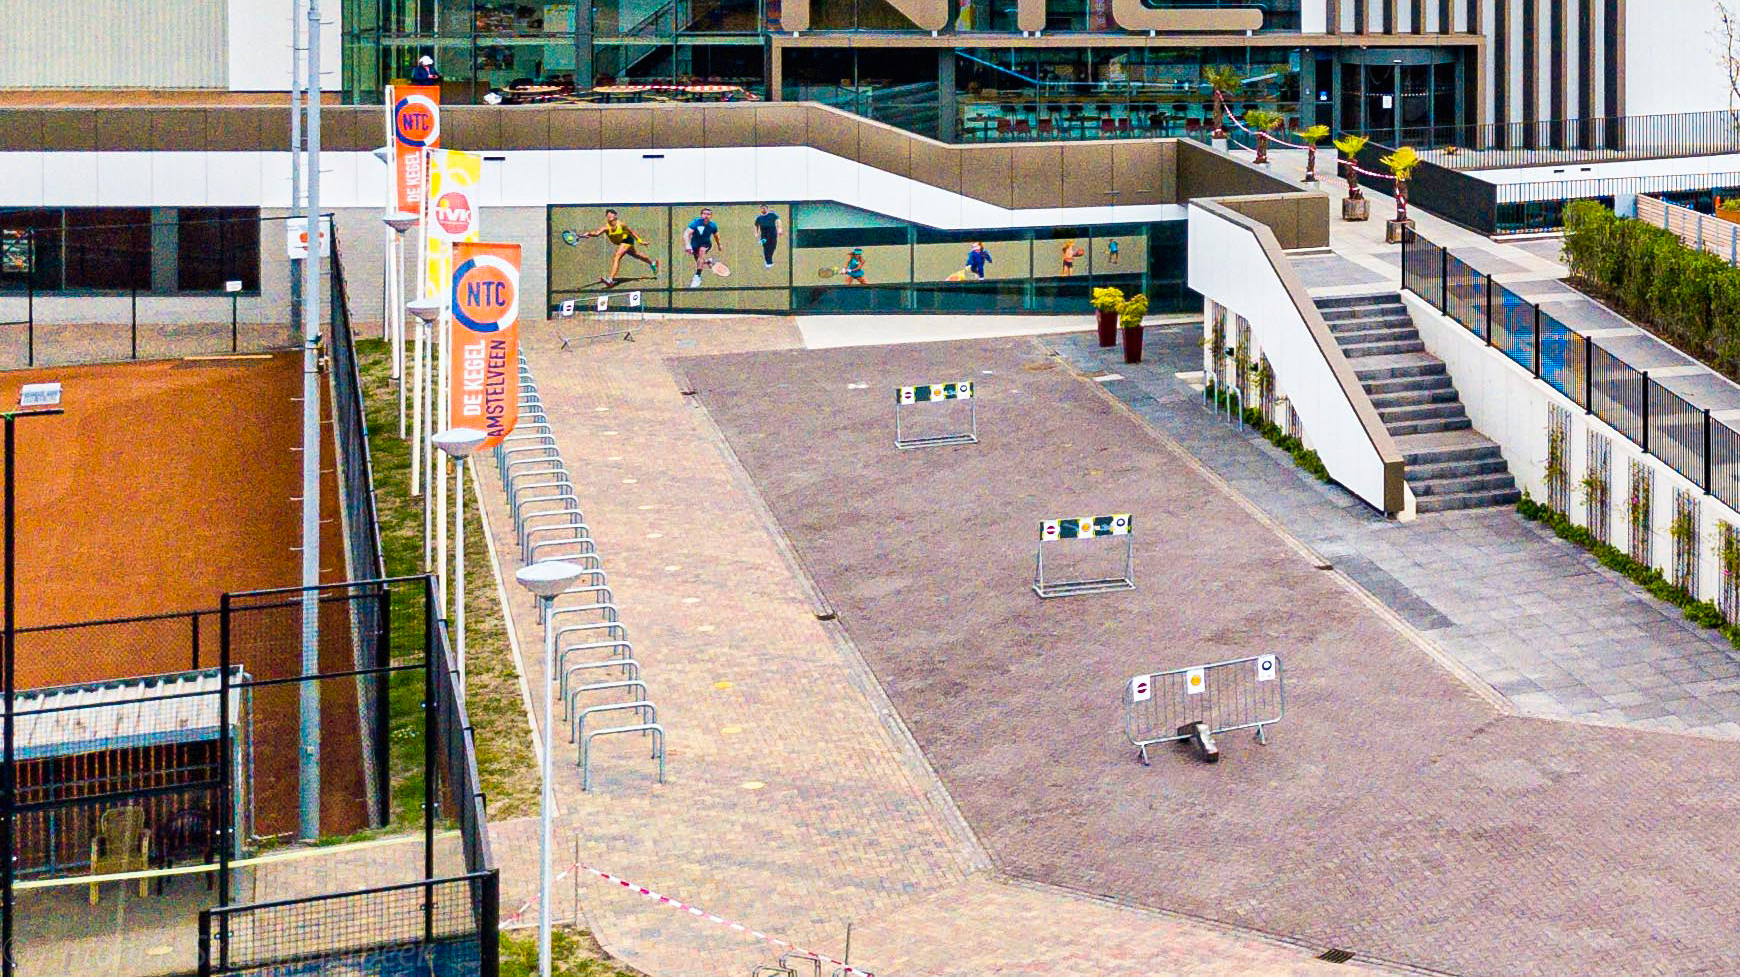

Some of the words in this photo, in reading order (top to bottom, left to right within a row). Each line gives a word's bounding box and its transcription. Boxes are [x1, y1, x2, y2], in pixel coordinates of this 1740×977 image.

[401, 113, 430, 130] NTC
[405, 152, 421, 186] KEGEL
[407, 188, 421, 202] DE
[467, 281, 506, 307] NTC
[463, 340, 485, 391] KEGEL
[486, 339, 507, 437] AMSTELVEEN
[463, 395, 483, 416] DE
